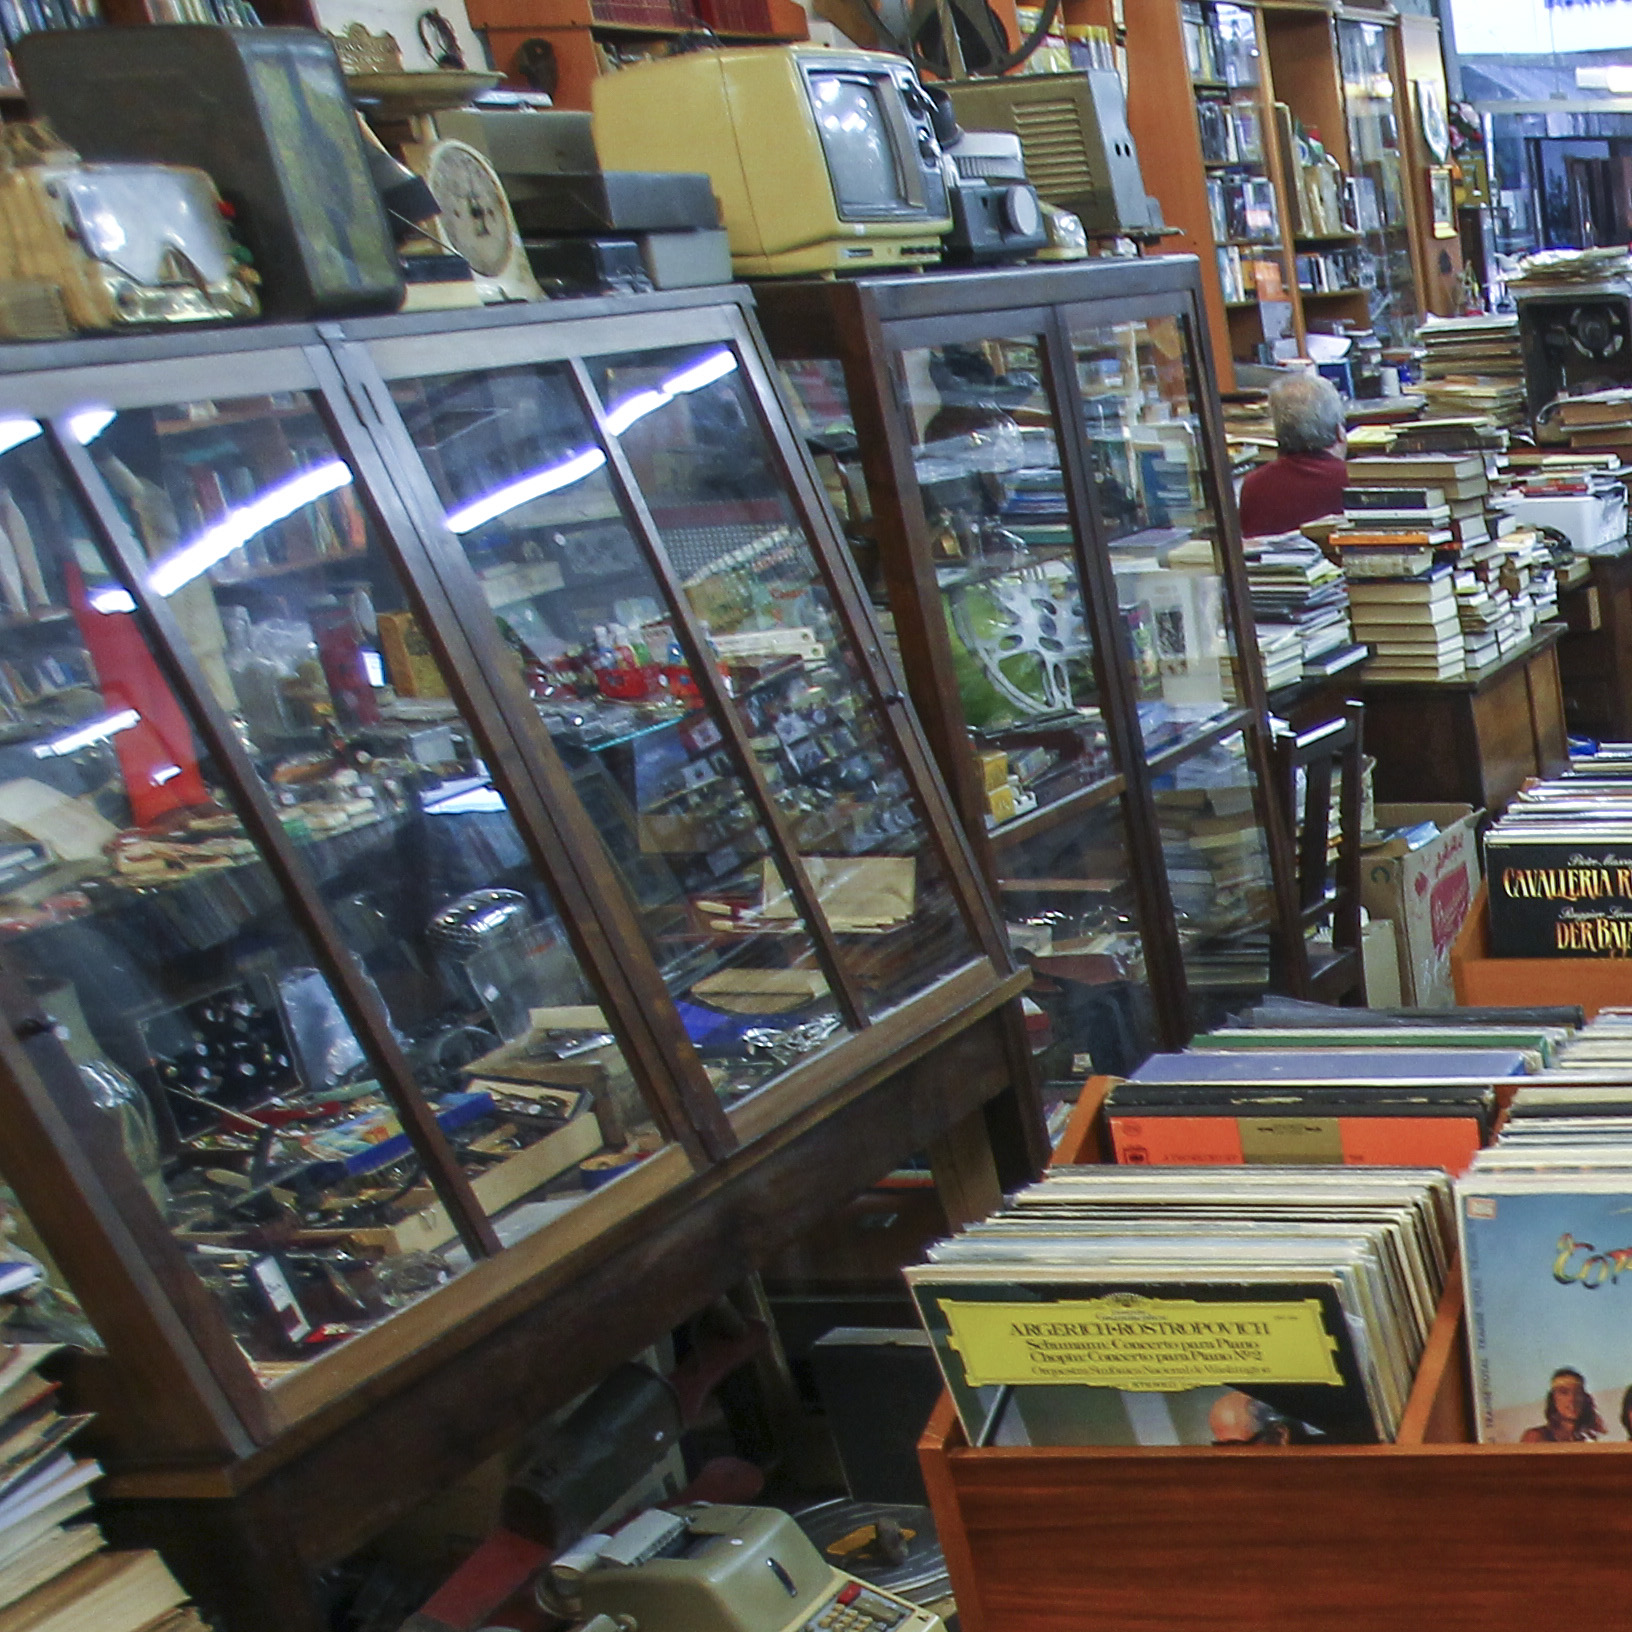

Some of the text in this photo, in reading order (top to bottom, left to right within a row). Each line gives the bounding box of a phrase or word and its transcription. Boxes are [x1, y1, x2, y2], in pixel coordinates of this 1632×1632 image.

[1503, 867, 1614, 902] CAVALLERIA
[1555, 921, 1597, 952] DER
[1111, 1338, 1259, 1353] Concerto para Piano
[1088, 1351, 1230, 1365] Concerto para Piano
